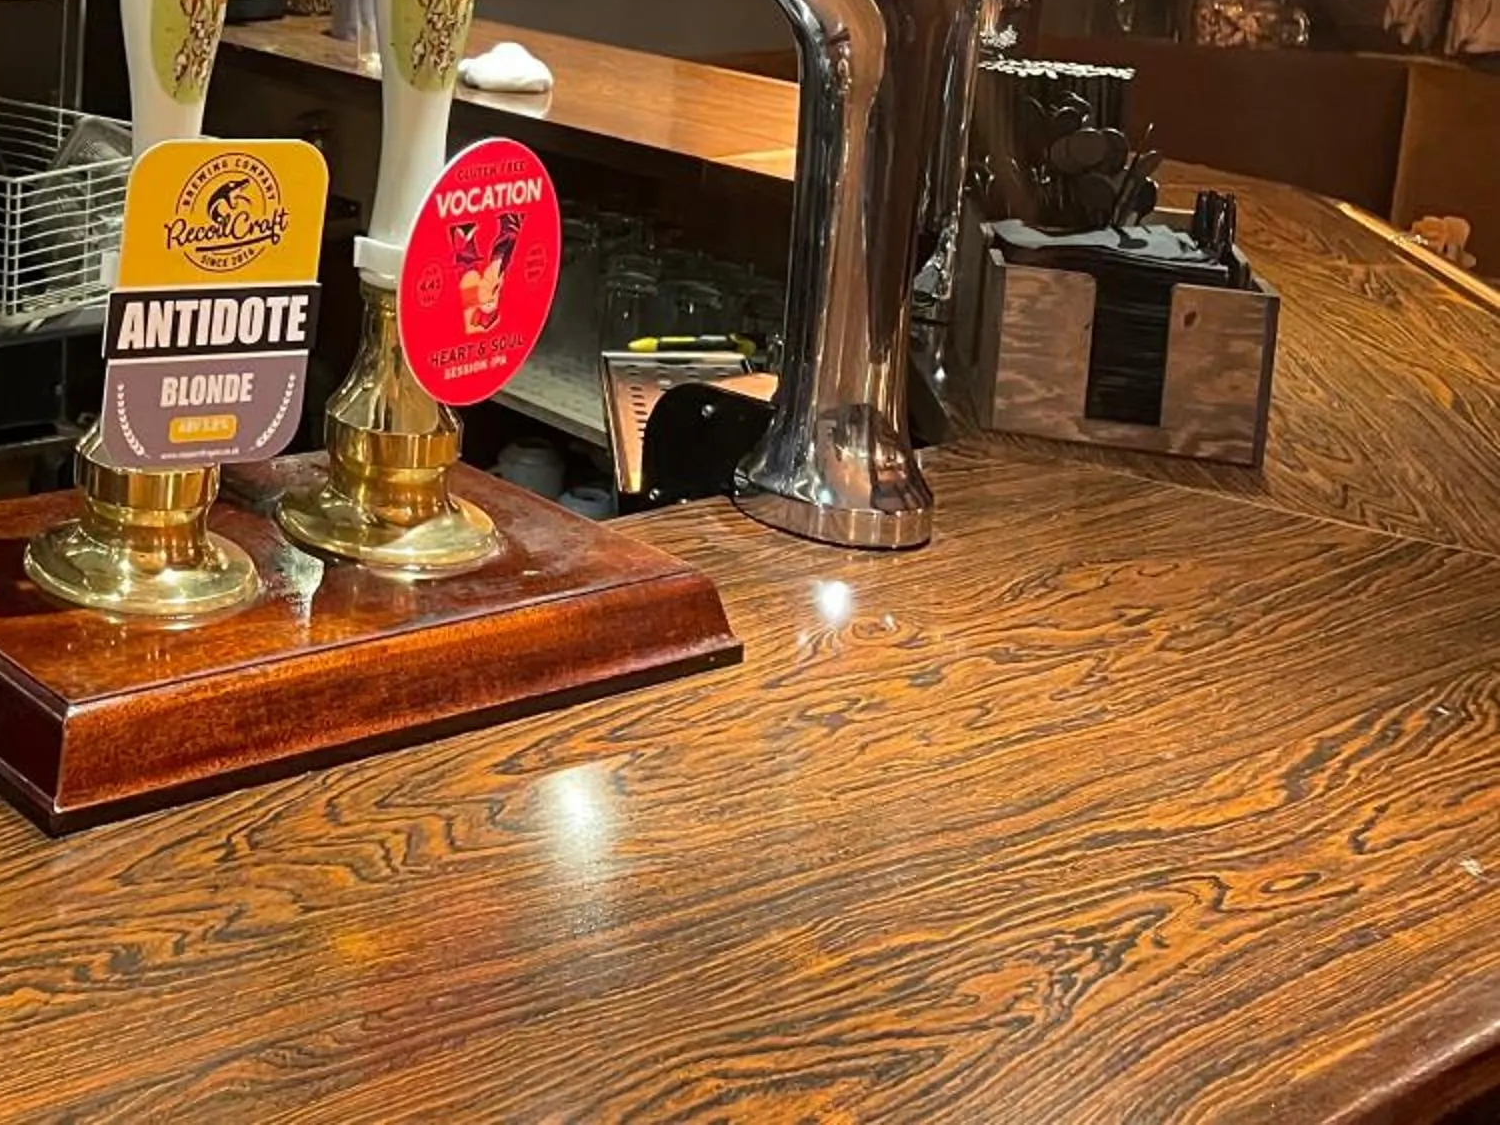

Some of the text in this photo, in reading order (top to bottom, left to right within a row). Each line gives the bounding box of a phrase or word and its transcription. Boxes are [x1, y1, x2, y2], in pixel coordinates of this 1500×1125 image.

[182, 158, 276, 206] BREWING COMPANY
[457, 164, 496, 182] GLUTEN
[435, 176, 543, 219] VOCATION
[200, 254, 228, 268] SINCE
[117, 295, 309, 351] ANTIDOTE
[430, 345, 474, 367] HEART
[492, 334, 524, 351] SOUL
[159, 373, 255, 408] BLONDE
